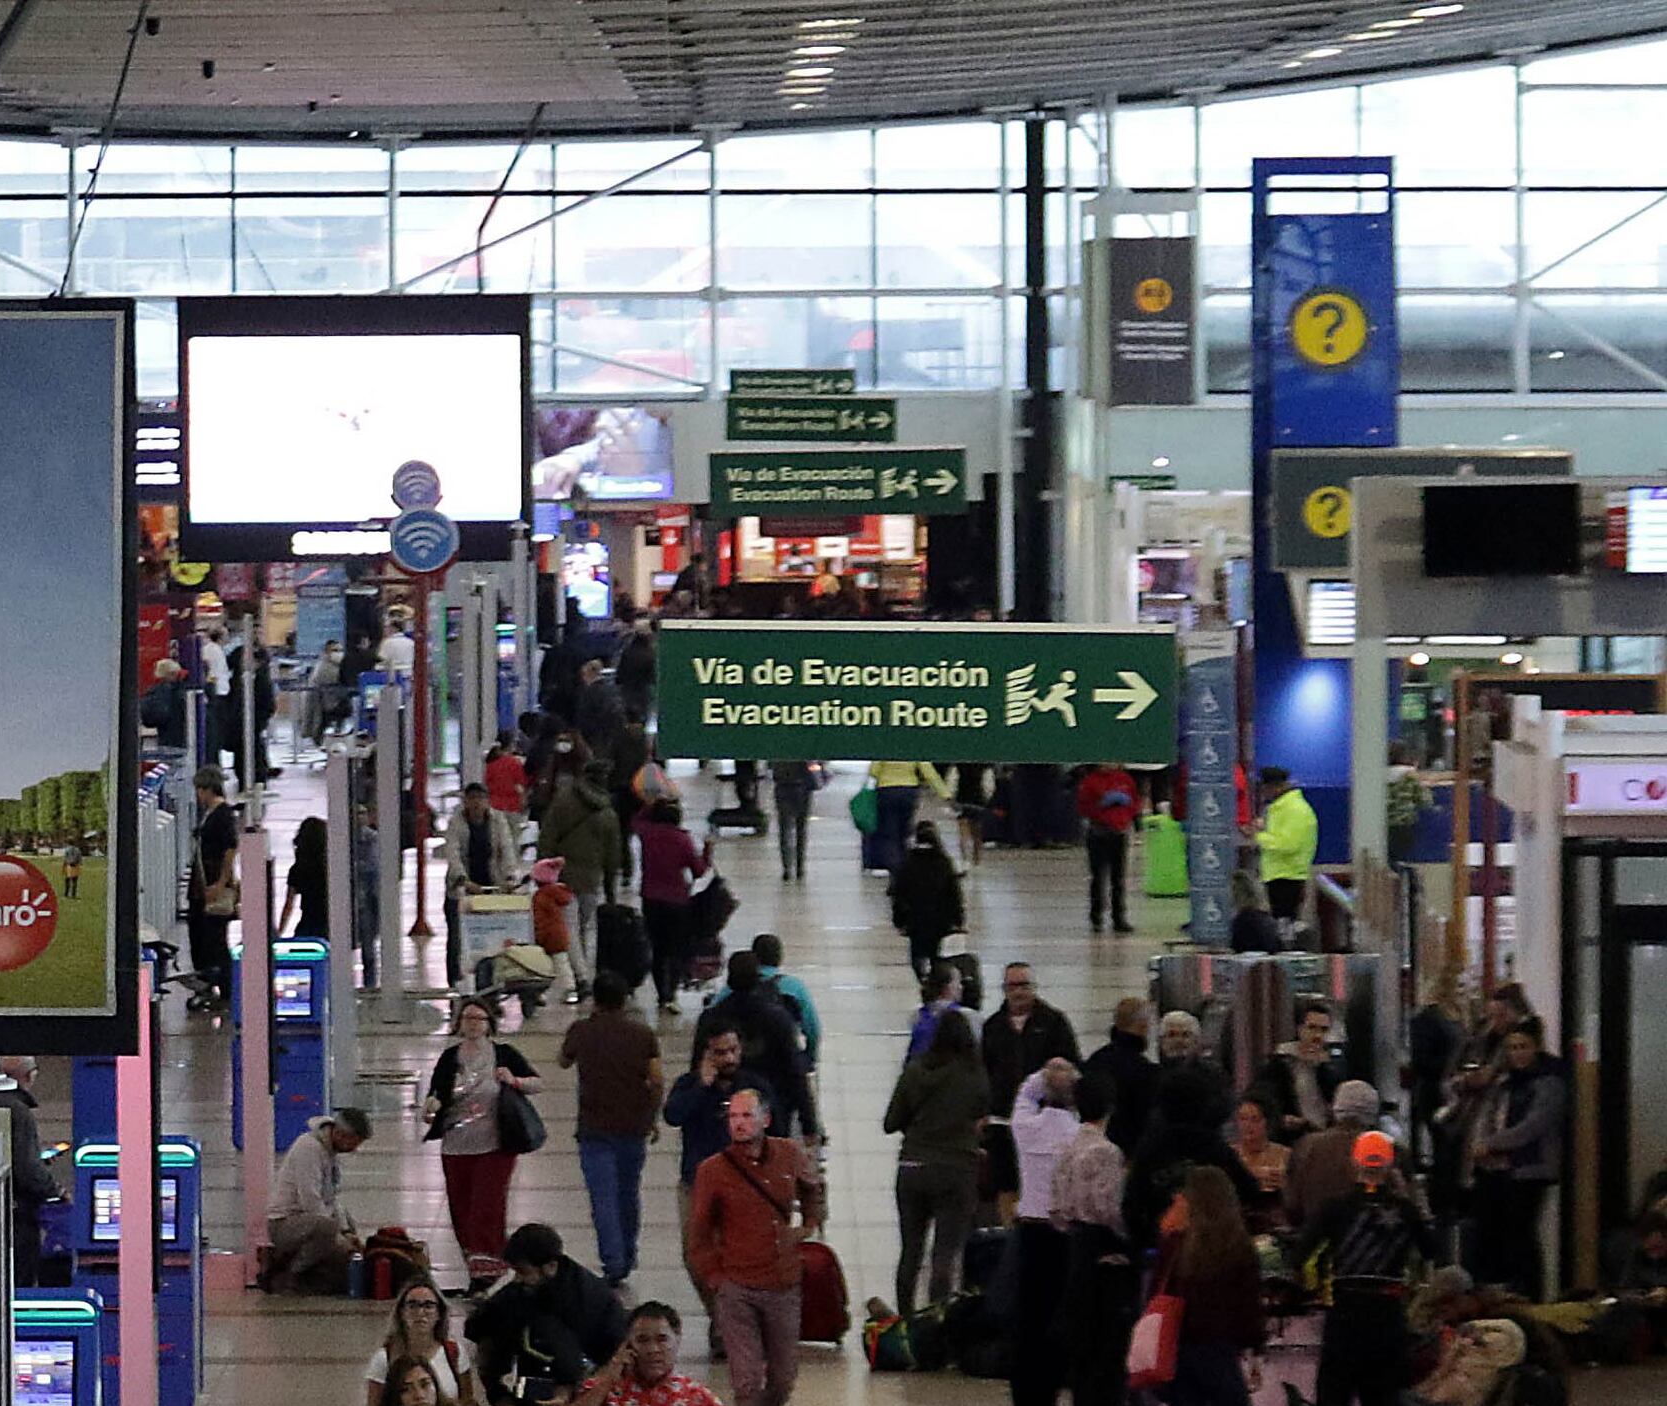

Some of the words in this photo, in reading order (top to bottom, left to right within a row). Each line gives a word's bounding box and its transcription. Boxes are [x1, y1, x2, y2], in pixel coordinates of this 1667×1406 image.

[757, 467, 776, 482] de
[730, 486, 822, 502] Evacuation
[823, 486, 875, 501] Route
[692, 657, 745, 687] Vía
[751, 658, 795, 687] de
[801, 658, 990, 688] Evacuación
[701, 698, 882, 728] Evacuation
[890, 698, 989, 728] Route
